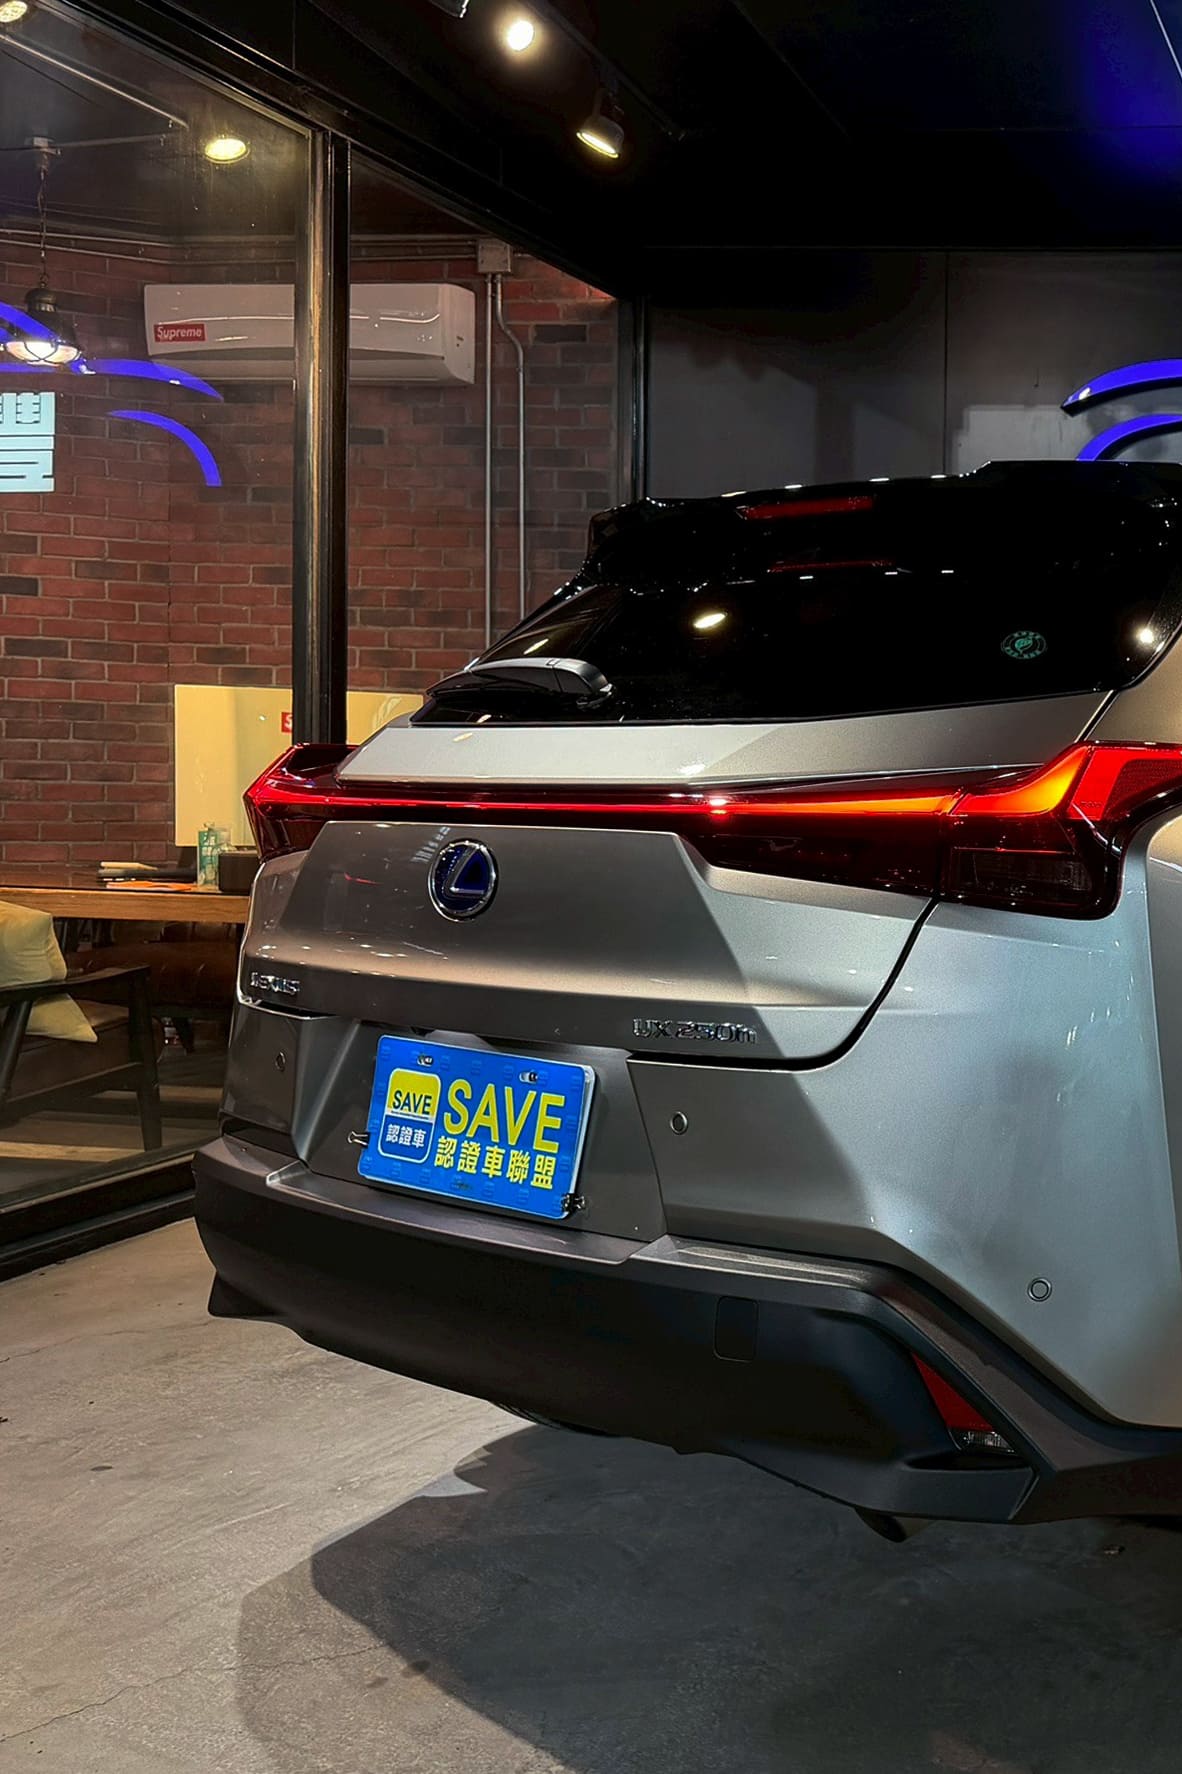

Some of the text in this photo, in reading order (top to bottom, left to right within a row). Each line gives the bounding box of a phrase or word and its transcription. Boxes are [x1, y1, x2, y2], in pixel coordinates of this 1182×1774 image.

[157, 326, 202, 341] Supreme
[392, 1089, 432, 1116] SAVE
[443, 1079, 565, 1154] SAVE
[385, 1123, 428, 1149] 認證車
[434, 1135, 557, 1190] 認證車聯盟
